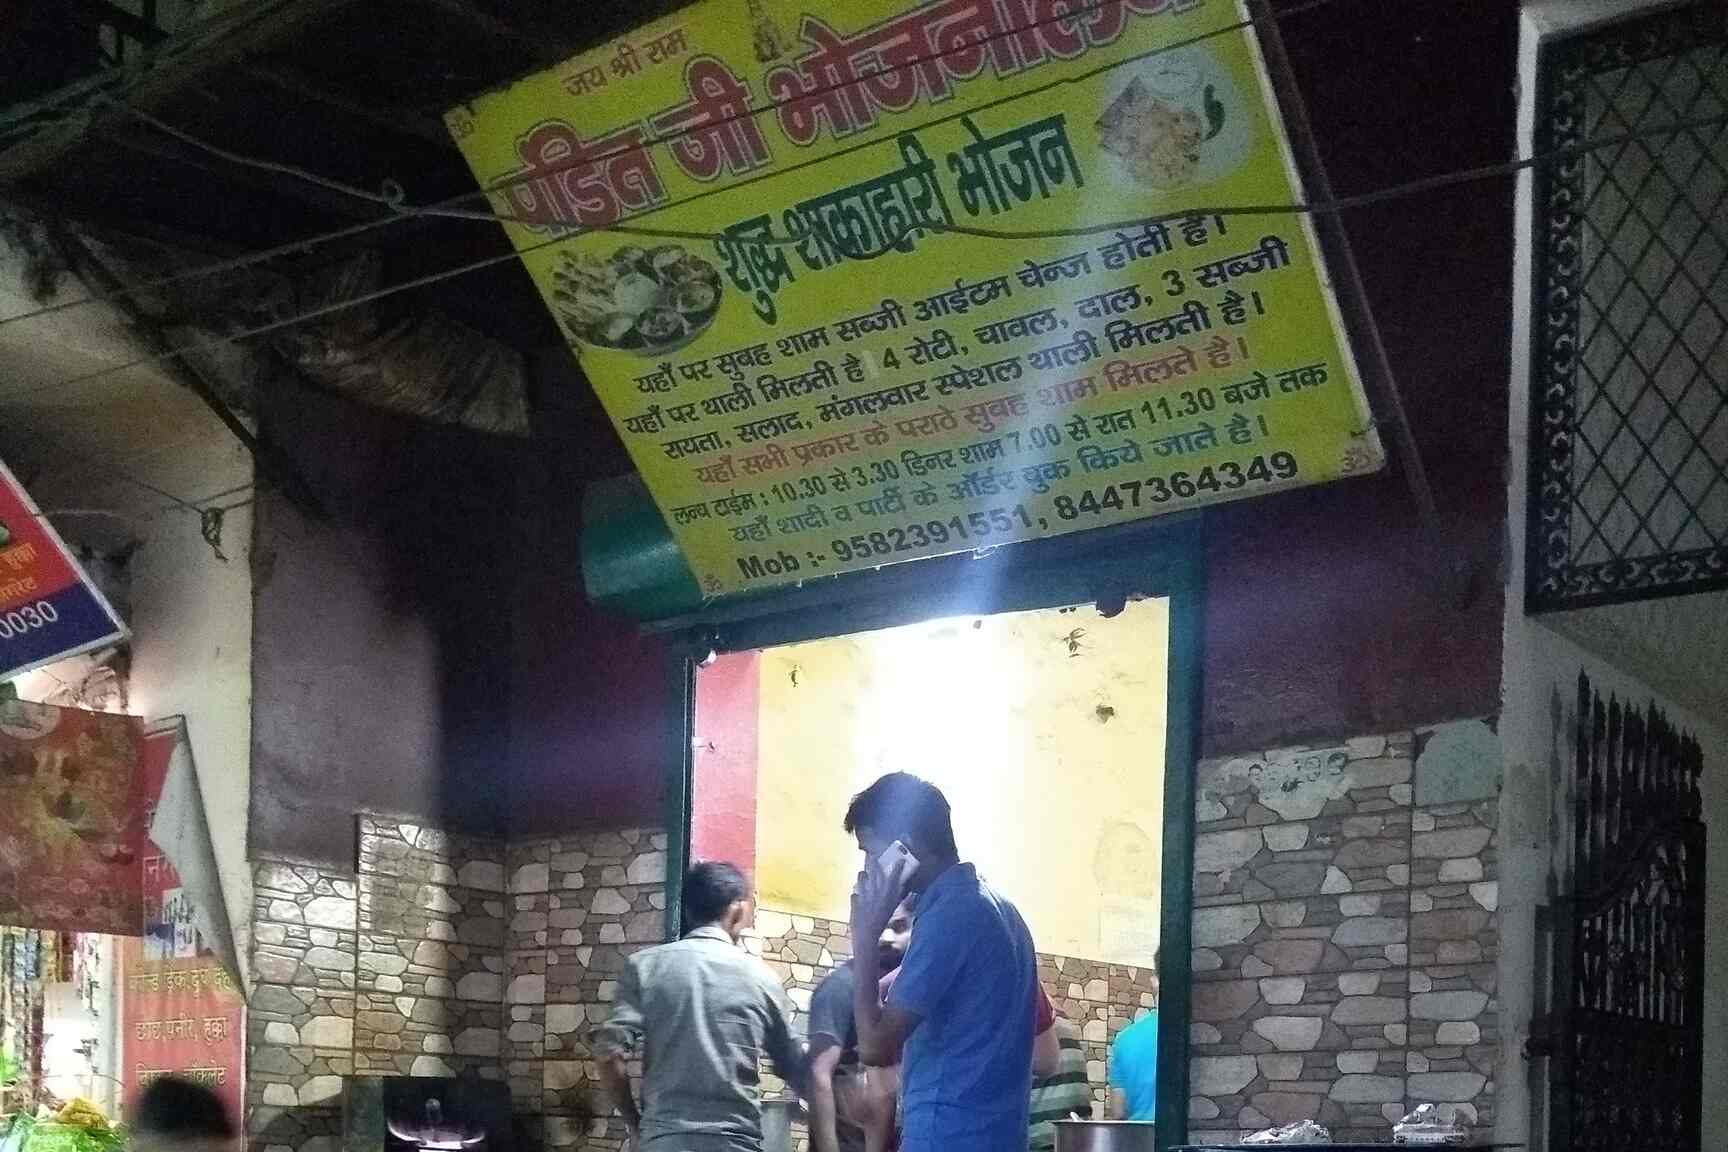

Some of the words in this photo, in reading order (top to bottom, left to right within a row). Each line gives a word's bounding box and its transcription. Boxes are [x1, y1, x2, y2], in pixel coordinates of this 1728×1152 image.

[560, 65, 609, 97] जय
[610, 41, 643, 79] श्री
[642, 29, 688, 65] राम
[647, 53, 774, 182] जी
[946, 112, 1085, 217] भोजन
[666, 402, 700, 426] पर
[701, 381, 757, 418] थाली
[756, 359, 840, 404] मिलती
[882, 347, 900, 371] 4
[1161, 268, 1186, 298] 3
[679, 359, 713, 382] पर
[775, 326, 832, 358] शाम
[1097, 222, 1173, 272] होती
[930, 356, 1023, 396] स्पेशल
[1027, 329, 1101, 372] थाली
[1102, 298, 1213, 354] मिलती
[737, 442, 790, 476] सभी
[791, 432, 862, 467] प्रकार
[863, 420, 891, 447] के
[890, 409, 960, 440] पराठे
[1034, 375, 1100, 407] शाम
[1101, 346, 1200, 394] मिलते
[771, 475, 828, 504] 10.30
[828, 469, 851, 496] से
[851, 458, 900, 489] 3.30
[899, 448, 957, 478] डिनर
[959, 437, 1007, 467] शाम
[1007, 421, 1062, 451] 7.00
[1064, 413, 1093, 442] से
[1095, 407, 1138, 436] रात
[1140, 386, 1216, 424] 11.30
[1219, 370, 1272, 406] बजे
[1274, 362, 1329, 394] तक
[736, 549, 800, 580] Mob
[1053, 450, 1298, 521] 8447364349
[776, 503, 829, 536] शादी
[913, 481, 940, 507] के
[1021, 456, 1073, 495] बुक
[1147, 420, 1221, 459] जाते
